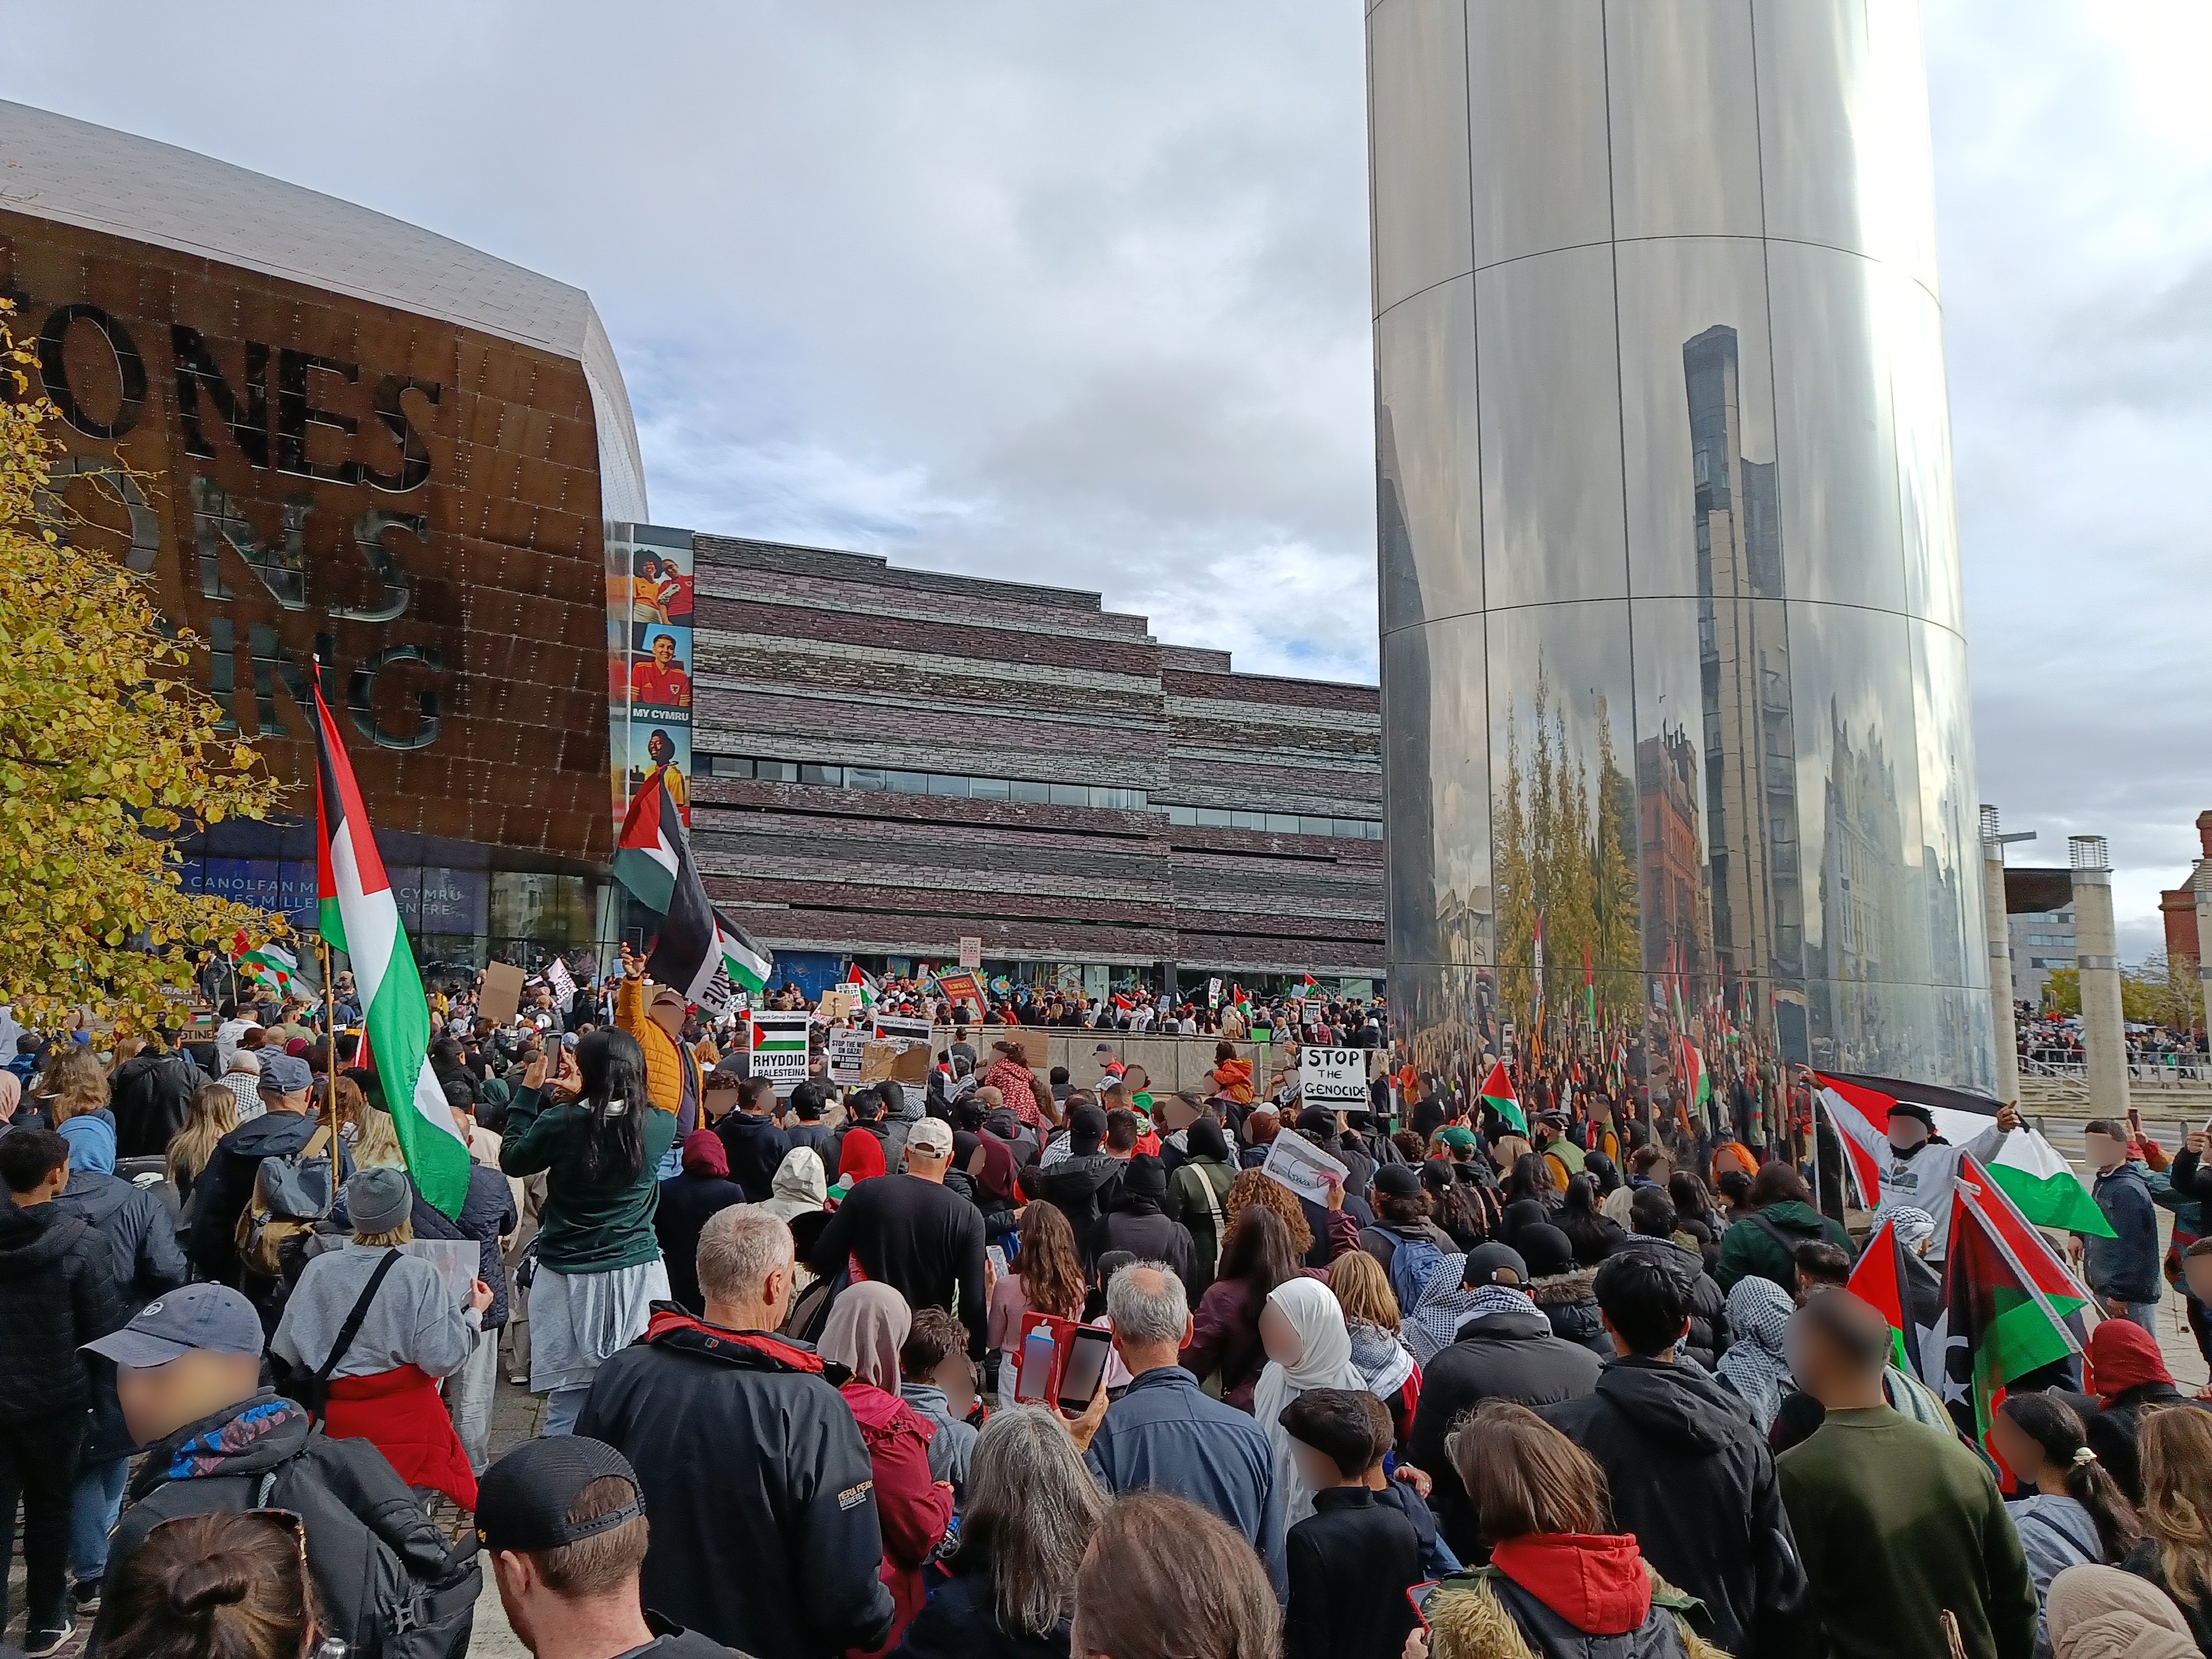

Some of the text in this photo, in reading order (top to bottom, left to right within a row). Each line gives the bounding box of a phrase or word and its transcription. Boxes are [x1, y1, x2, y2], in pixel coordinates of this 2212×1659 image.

[0, 286, 442, 494] ONES
[633, 708, 689, 721] MY CYMRU
[191, 876, 293, 893] CANOLFAN
[400, 887, 461, 901] CYMRU
[397, 902, 451, 915] ENTRE
[181, 1029, 213, 1040] STINE
[753, 1054, 806, 1067] RHYDDID
[1309, 1049, 1359, 1067] STOP
[758, 1068, 806, 1077] BALESTEINA
[1317, 1069, 1343, 1079] THE
[1305, 1082, 1366, 1097] GENOCIDE
